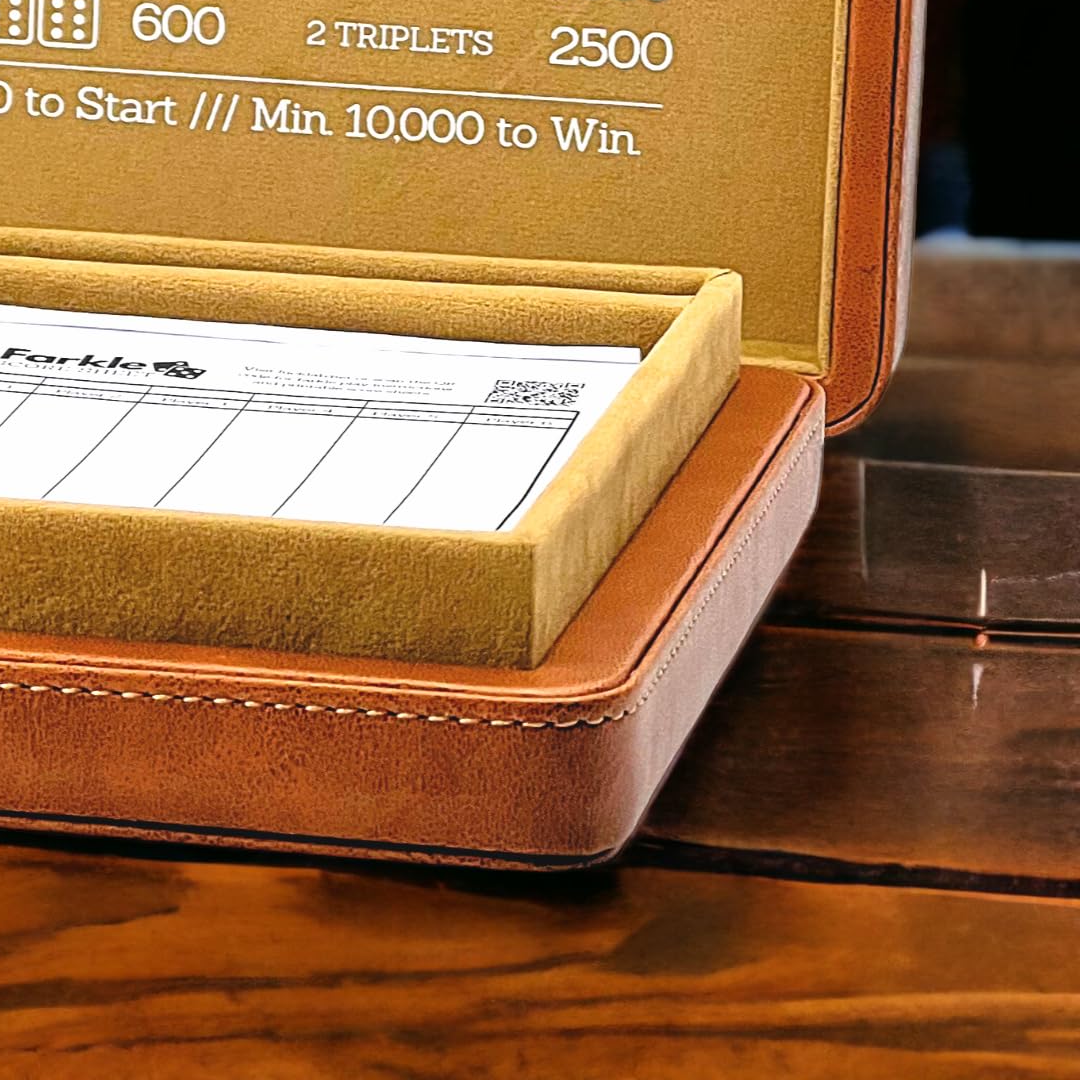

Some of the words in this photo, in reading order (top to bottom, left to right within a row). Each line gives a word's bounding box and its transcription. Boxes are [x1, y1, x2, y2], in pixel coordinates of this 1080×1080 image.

[133, 3, 225, 45] 600
[307, 20, 325, 45] 2
[335, 22, 493, 55] TRIPLETS
[549, 27, 673, 70] 2500
[25, 88, 64, 117] to
[76, 87, 177, 125] Start
[346, 104, 484, 144] 10,000
[497, 119, 537, 148] to
[0, 347, 146, 370] Farkle
